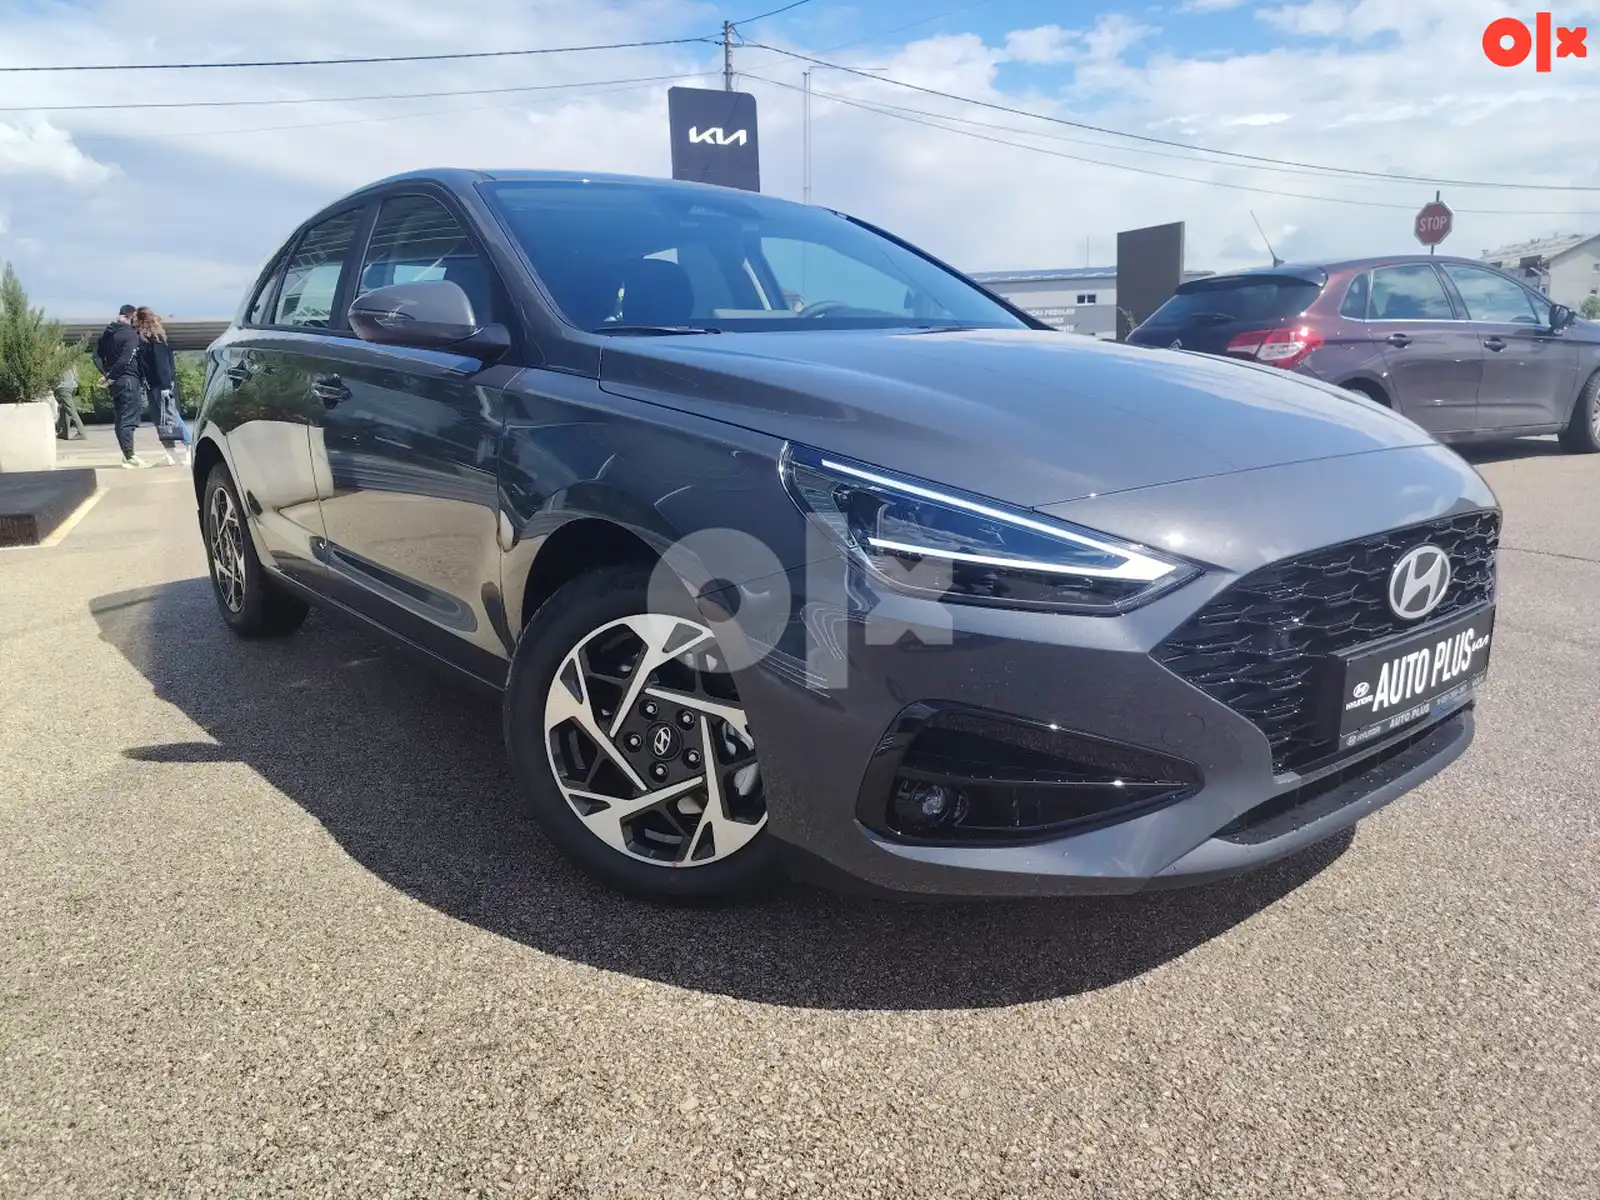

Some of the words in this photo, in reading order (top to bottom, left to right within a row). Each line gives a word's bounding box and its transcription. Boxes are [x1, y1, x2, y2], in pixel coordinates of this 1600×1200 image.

[688, 126, 747, 146] KIA
[1419, 215, 1447, 232] STOP
[1372, 648, 1429, 712] AUTO
[1431, 628, 1475, 687] PLUS
[1389, 711, 1410, 729] AUTO
[1411, 703, 1430, 720] PLUS
